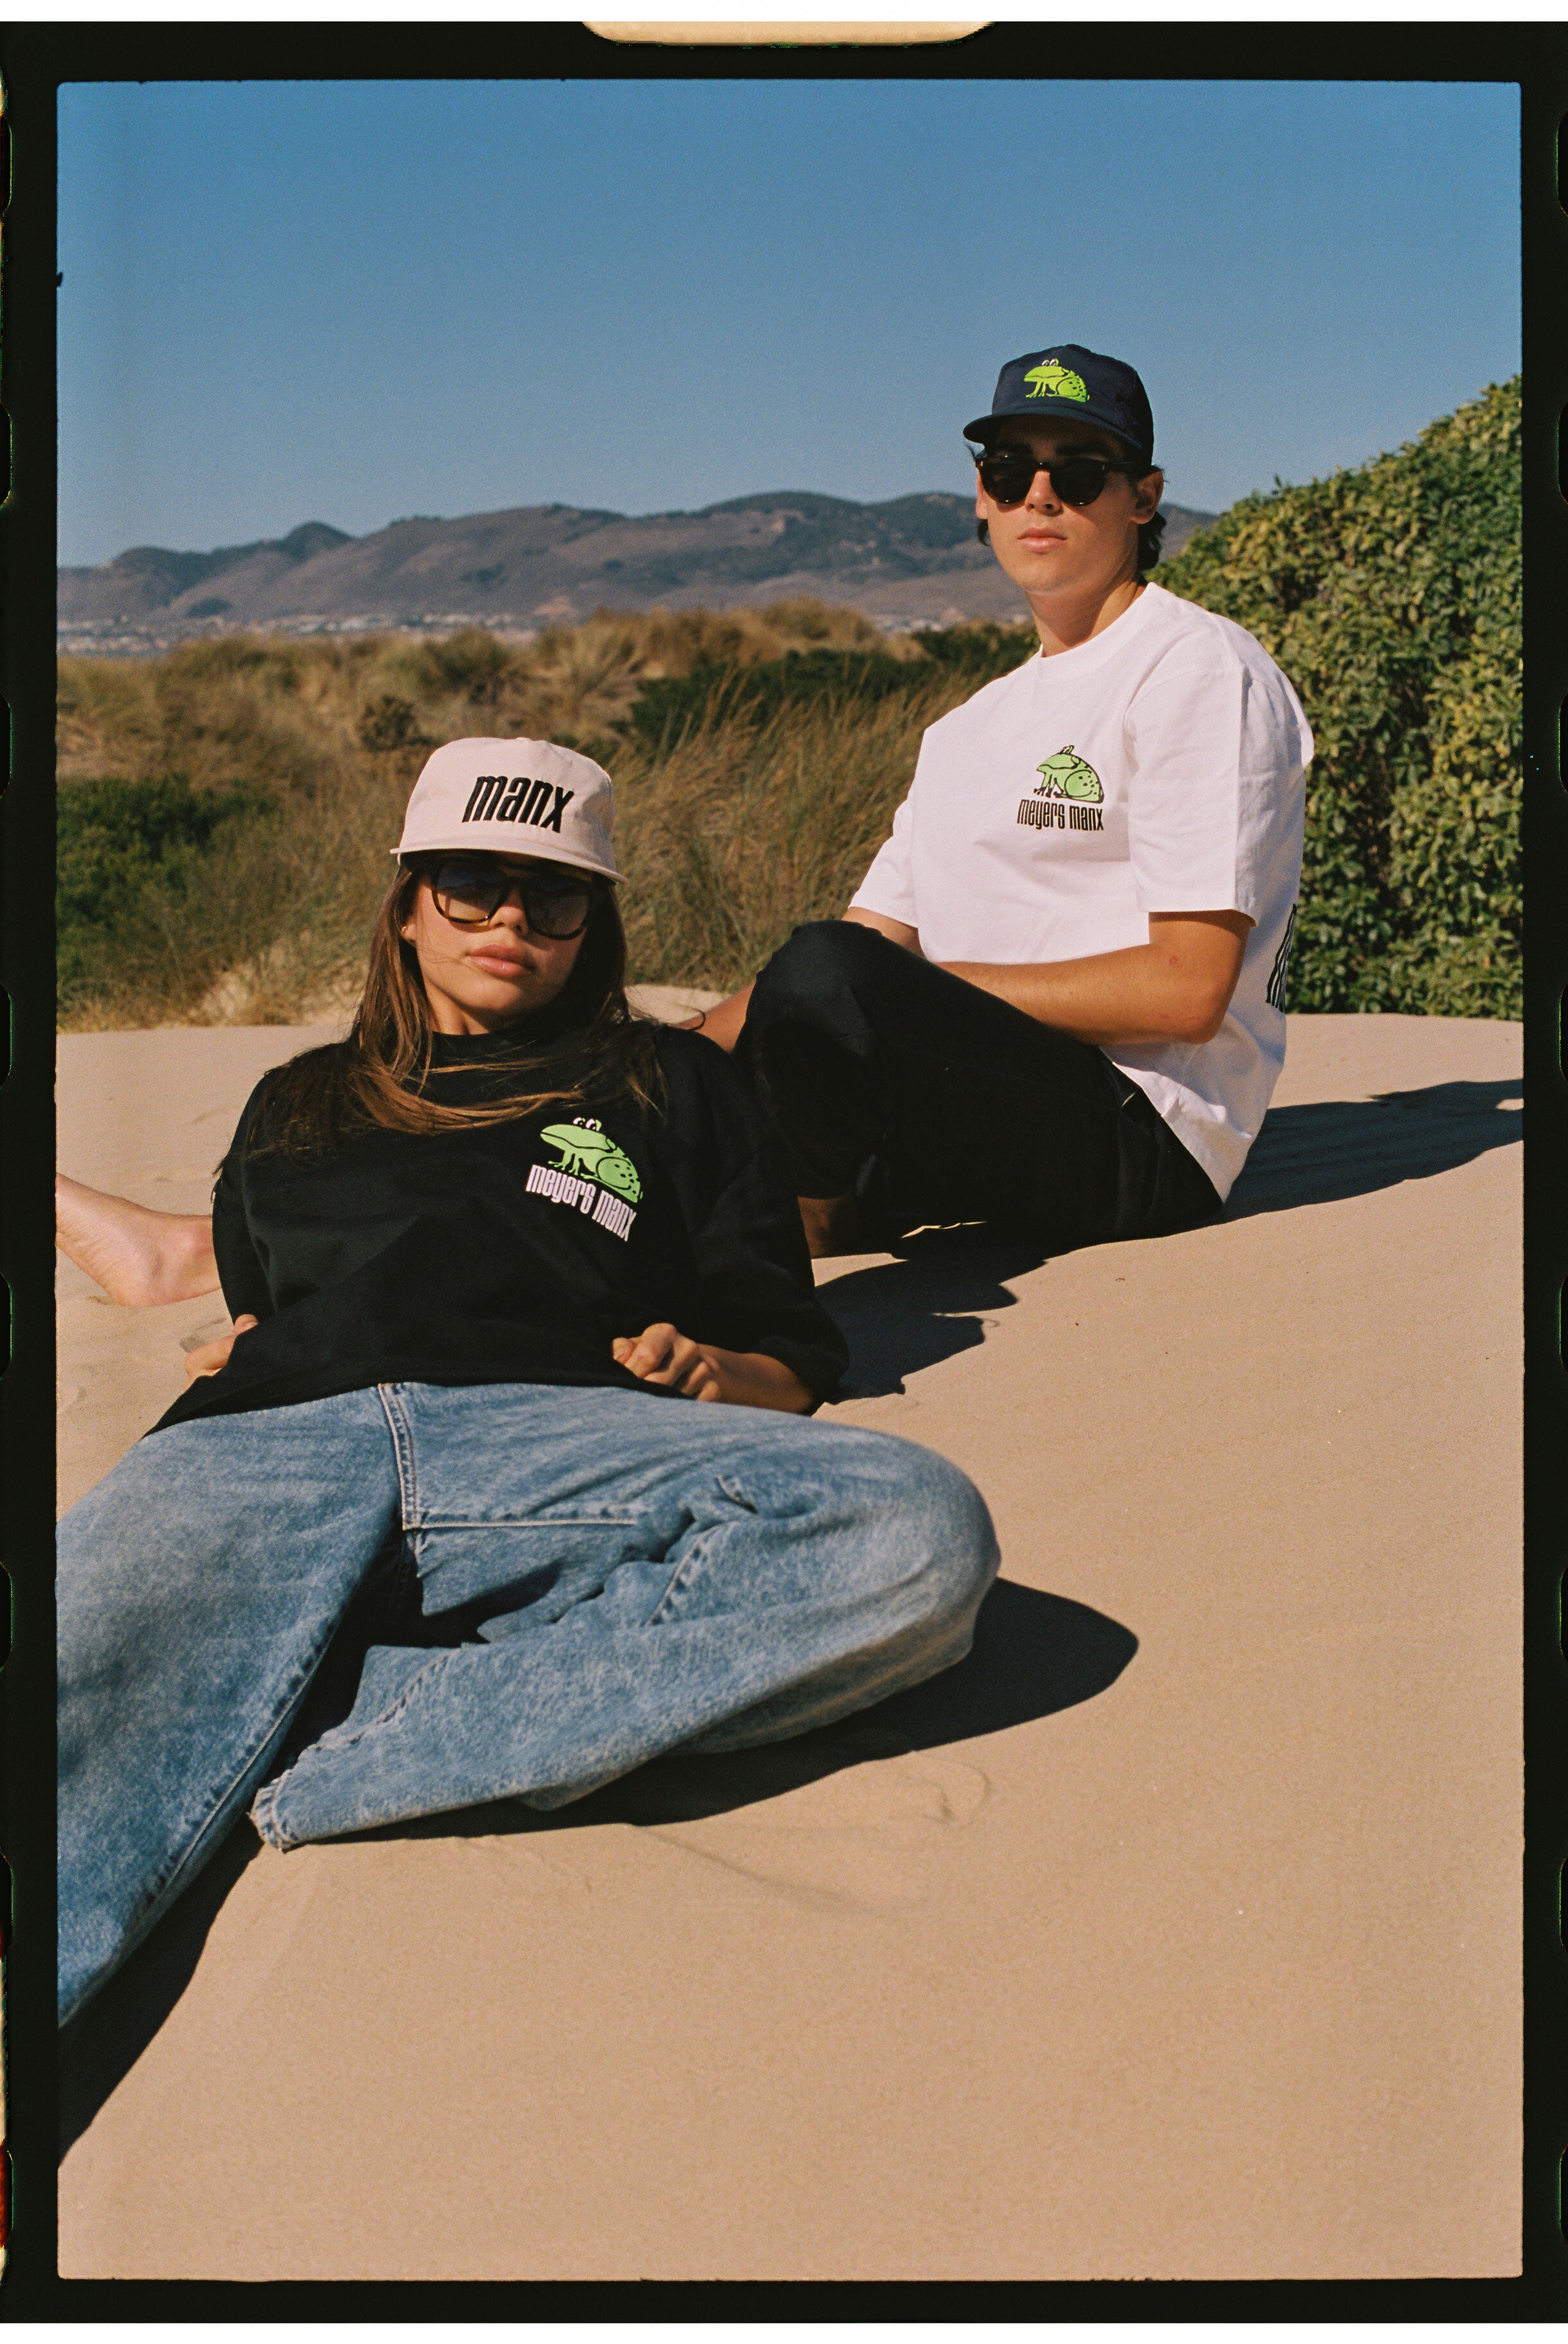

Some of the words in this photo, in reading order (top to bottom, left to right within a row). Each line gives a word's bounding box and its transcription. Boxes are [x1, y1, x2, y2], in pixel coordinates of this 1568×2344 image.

[461, 775, 575, 833] manx
[1016, 799, 1065, 830] meyers
[1069, 805, 1104, 831] manx
[525, 1164, 597, 1214] meyers
[592, 1190, 637, 1242] manx
